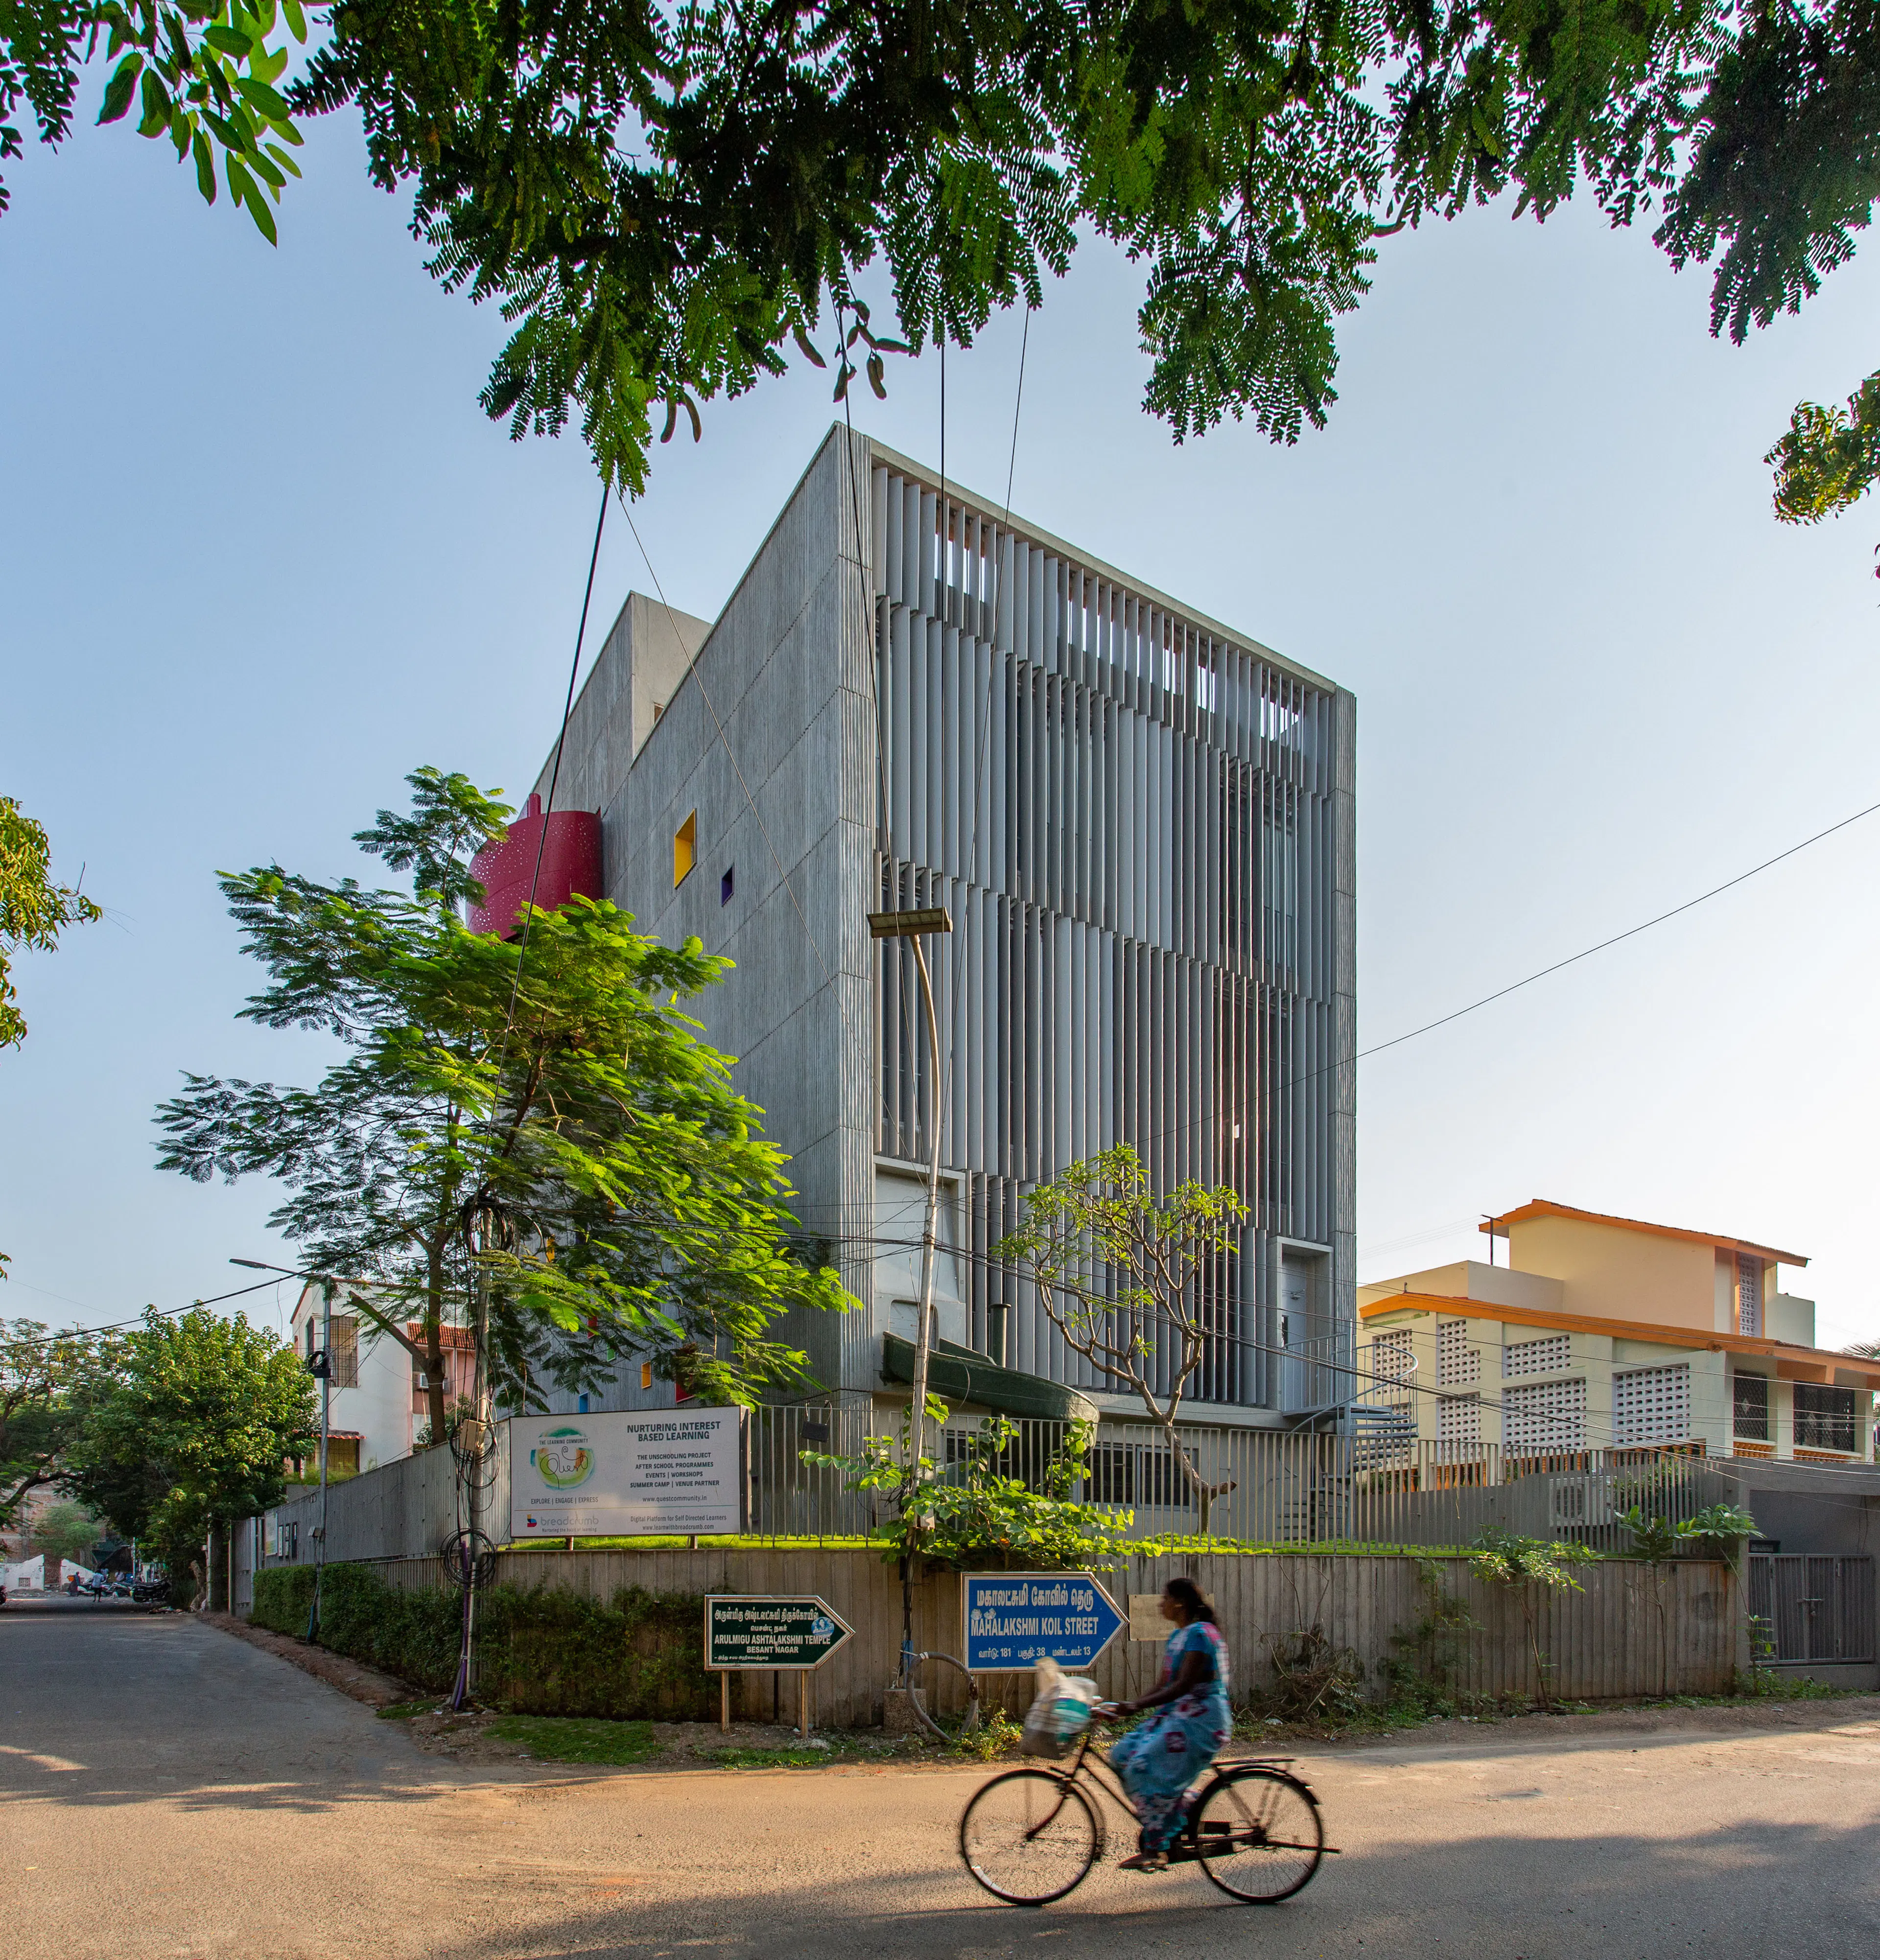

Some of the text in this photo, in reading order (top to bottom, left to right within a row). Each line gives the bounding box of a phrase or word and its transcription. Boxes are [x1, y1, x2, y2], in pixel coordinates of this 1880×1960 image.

[627, 1421, 721, 1433] NURTURING INTEREST
[638, 1431, 709, 1442] BASED LEARNING
[540, 1516, 599, 1526] breadcrumb
[977, 1583, 1094, 1611] மகாலட்சுமி கோவில் தெரு
[971, 1617, 1099, 1636] MAHALAKSHMI KOIL STREET
[714, 1634, 831, 1644] ARULMIGU ASHTALAKSHMI TEMPLE
[979, 1646, 1091, 1659] வார்டு: 181 பகுதி: 38 மண்டலம்: 13
